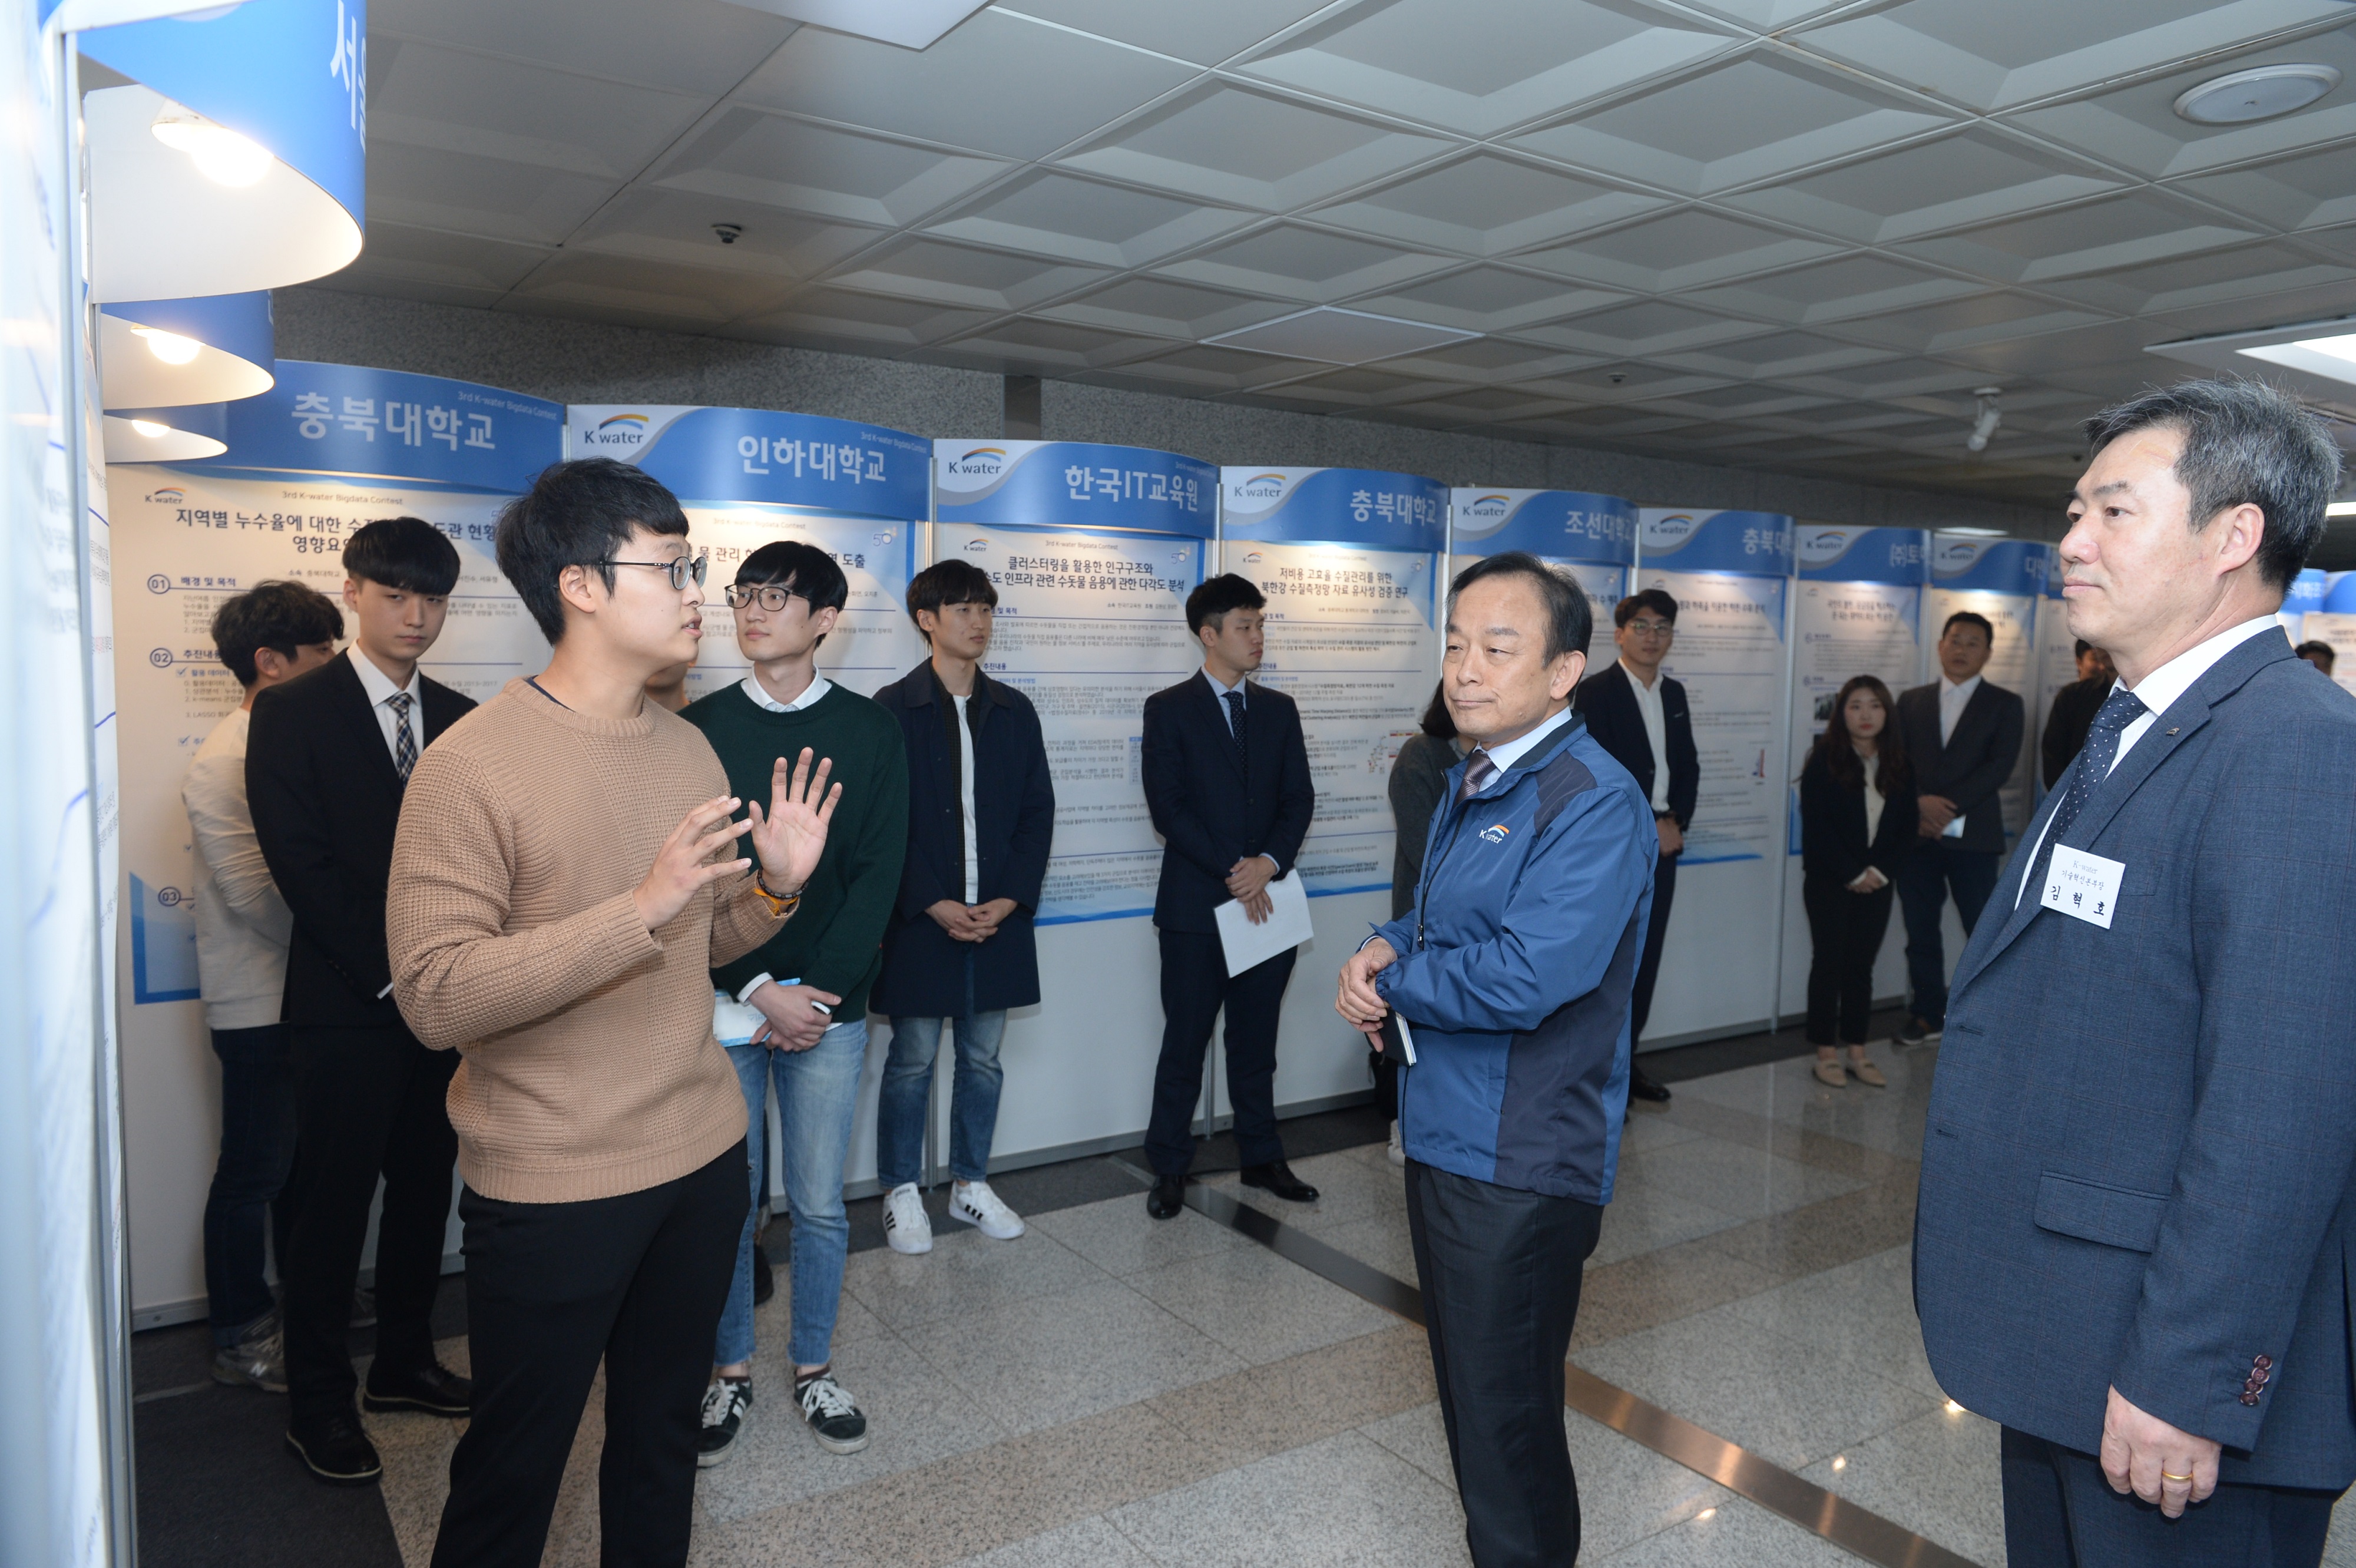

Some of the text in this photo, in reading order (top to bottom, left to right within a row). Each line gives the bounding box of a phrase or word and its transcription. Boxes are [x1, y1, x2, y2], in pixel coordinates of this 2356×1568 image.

[458, 391, 472, 402] 3rd
[475, 395, 505, 408] K-water
[507, 400, 532, 413] Bigdata
[292, 392, 495, 451] 충북대학교
[585, 432, 643, 445] K water
[737, 435, 886, 484] 인하대학교
[949, 462, 1001, 474] K water
[1065, 465, 1198, 512] 한국IT교육원
[1246, 488, 1282, 498] water
[282, 491, 403, 505] 3rd K-water Bigdata Contest
[1350, 490, 1436, 526] 충북대학교
[1474, 506, 1505, 517] water
[176, 509, 228, 529] 지역별
[235, 512, 302, 531] 누수율에
[309, 516, 341, 533] 대한
[716, 547, 740, 563] 관리
[842, 553, 866, 568] 도출
[1008, 556, 1153, 576] 클러스터링을 활용한 인구구조와
[180, 576, 236, 587] 배경 및 목적
[1004, 573, 1034, 587] 인프라
[1035, 573, 1055, 587] 관련
[1057, 575, 1086, 589] 수돗물
[1088, 576, 1116, 590] 음용에
[1119, 577, 1137, 591] 관한
[1139, 578, 1167, 591] 다각도
[1169, 579, 1184, 593] 분석
[1280, 567, 1392, 584] 저비용 고효율 수질관리를 위한
[151, 579, 166, 589] 01
[1262, 581, 1408, 598] 북한강 수질측정망 자료 유사성 검증 연구
[154, 653, 168, 663] 02
[1479, 829, 1488, 839] K
[2073, 861, 2098, 875] K-water
[2062, 869, 2104, 891] 기술혁신본부장
[163, 892, 176, 902] 03
[2050, 885, 2105, 916] 김 혁 호
